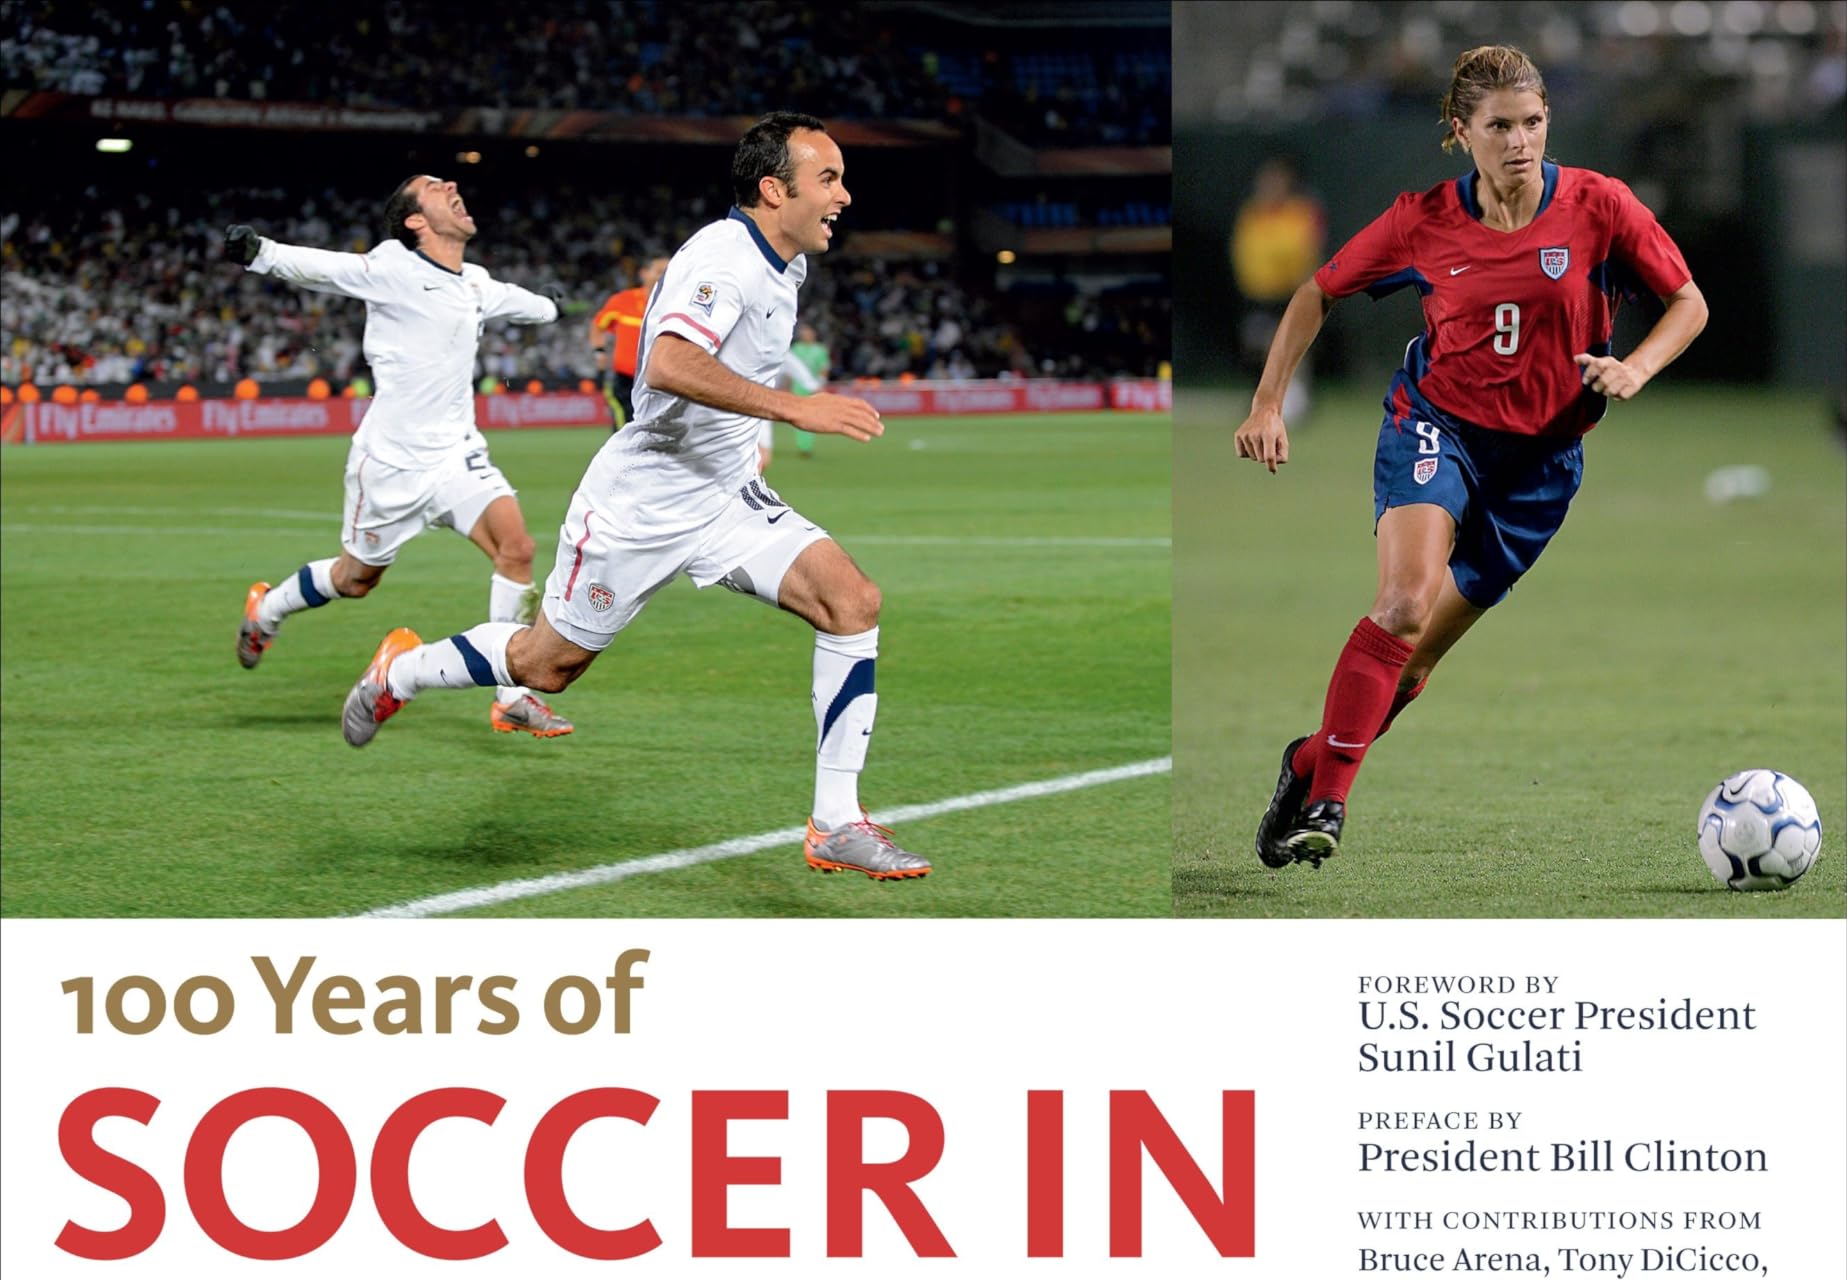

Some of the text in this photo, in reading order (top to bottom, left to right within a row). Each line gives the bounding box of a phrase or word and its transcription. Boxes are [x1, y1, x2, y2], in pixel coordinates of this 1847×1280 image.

[1493, 303, 1520, 355] 9
[39, 402, 176, 439] Fly Emirates
[203, 400, 239, 435] Fly
[241, 401, 328, 429] Emirates
[1416, 421, 1440, 454] 9
[61, 949, 650, 1035] 100 Years of
[1360, 976, 1559, 993] FOREWORD BY
[1359, 998, 1756, 1029] U.S. Soccer President
[1360, 1040, 1583, 1072] Sunil Gulati
[1359, 1112, 1522, 1130] PREFACE BY
[1359, 1140, 1768, 1172] President Bill Clinton
[54, 1087, 1256, 1260] SOCCER IN
[1358, 1212, 1760, 1229] WITH CONTRIBUTIONS FROM
[1359, 1246, 1768, 1279] Bruce Arena, Tony DiCicco,
